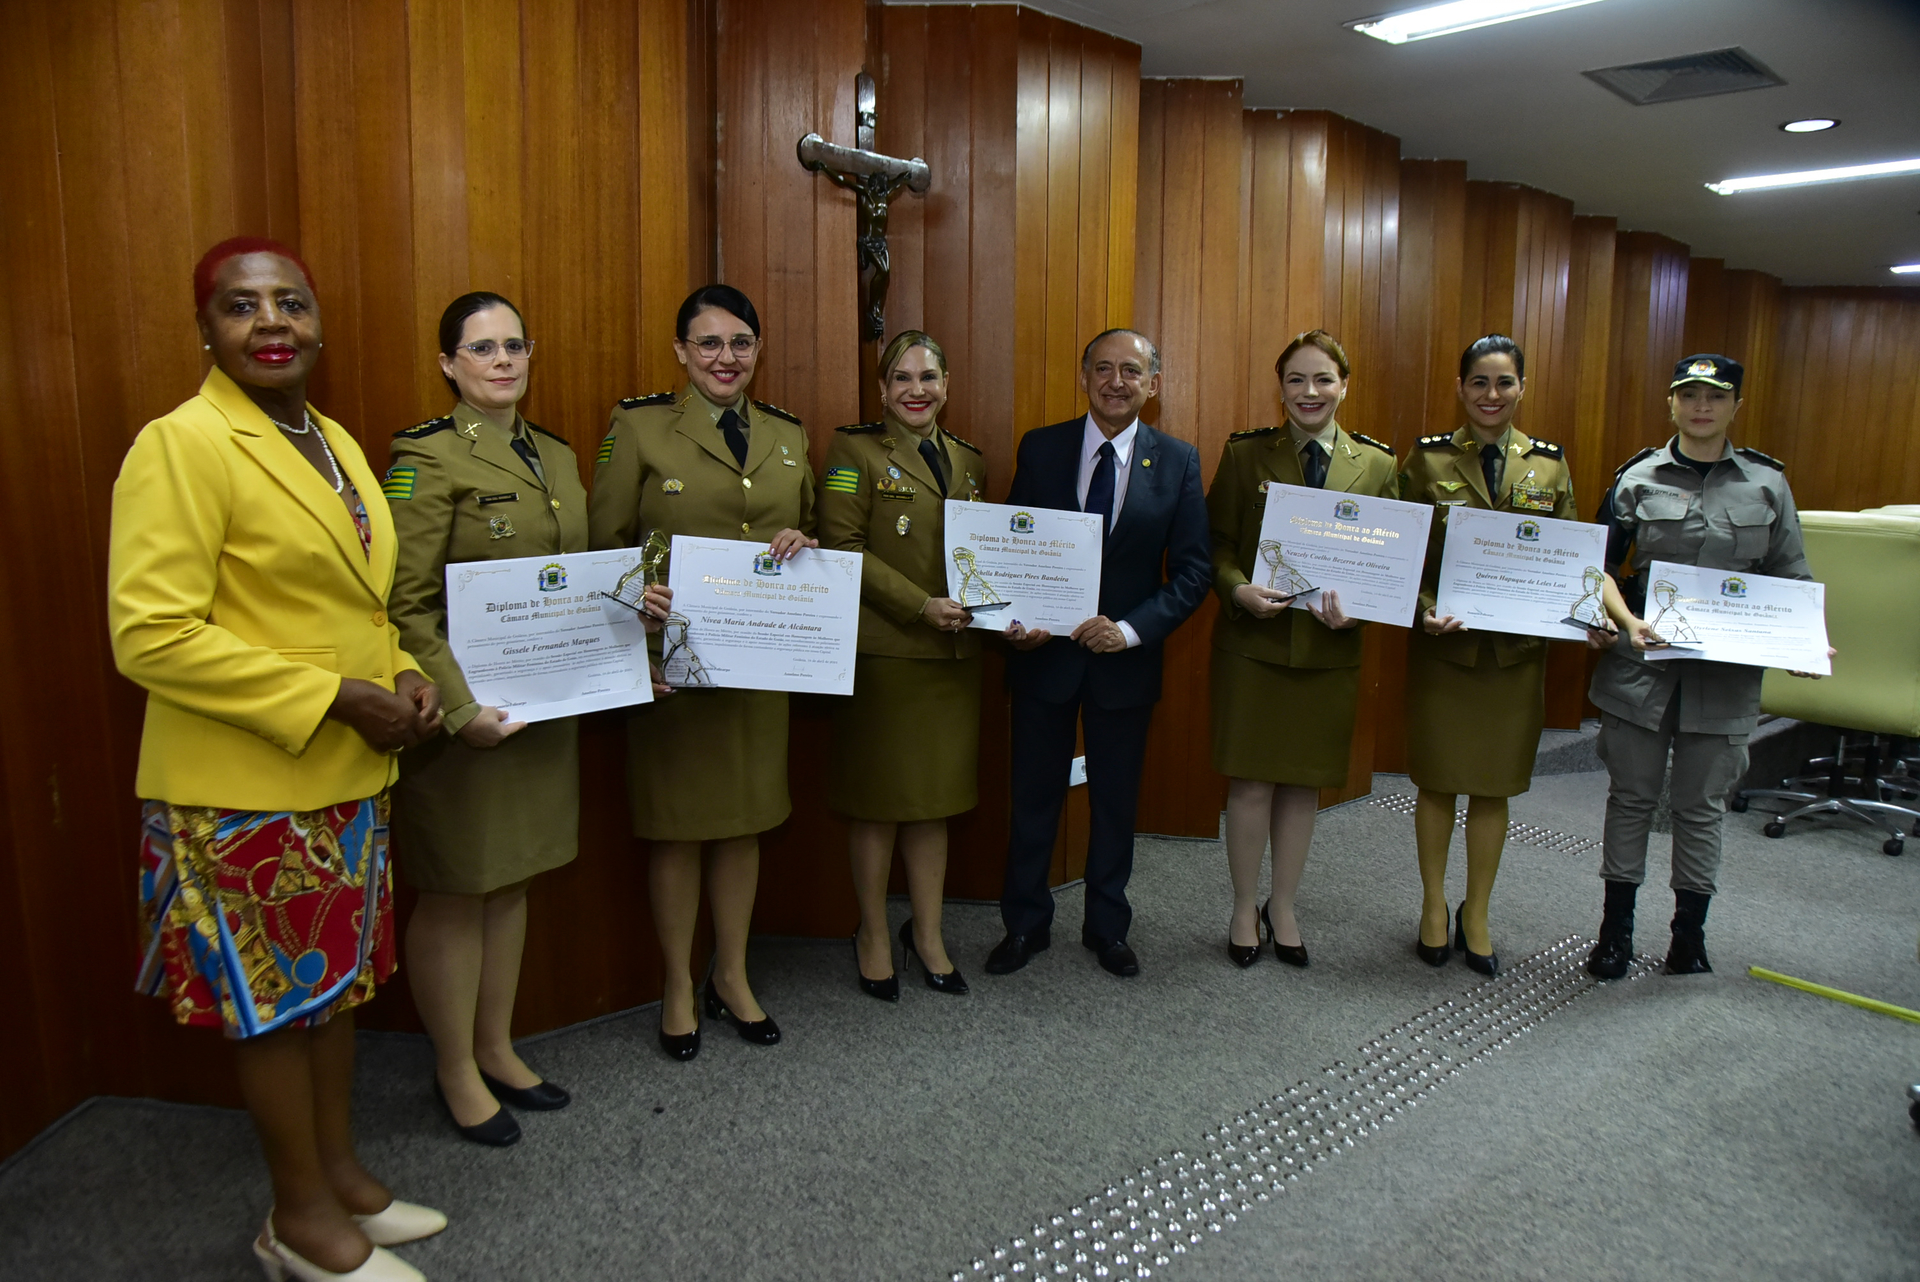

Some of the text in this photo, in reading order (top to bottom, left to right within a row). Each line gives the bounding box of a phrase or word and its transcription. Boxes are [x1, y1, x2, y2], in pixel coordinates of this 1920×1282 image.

[1335, 522, 1359, 532] Honra
[1372, 528, 1399, 538] Mérito
[969, 533, 999, 542] Diploma
[1012, 536, 1036, 545] Honra
[1049, 540, 1075, 549] Mérito
[1323, 531, 1352, 540] Municipal
[1361, 536, 1384, 545] Goiânia
[1001, 546, 1029, 554] Municipal
[1474, 537, 1504, 548] Diploma
[1517, 543, 1540, 553] Honra
[1553, 548, 1579, 558] Mérito
[1285, 550, 1308, 559] Neuzely
[1332, 557, 1356, 565] Bezerra
[1366, 562, 1390, 570] Oliveira
[1506, 552, 1534, 561] Municipal
[1543, 557, 1565, 565] Goiânia
[994, 570, 1022, 579] Rodrigues
[1041, 574, 1069, 582] Bandeira
[1476, 572, 1498, 580] Quéren
[1499, 575, 1526, 584] Hapuque
[702, 575, 741, 586] Diploma
[743, 579, 753, 587] de
[756, 579, 784, 590] Honra
[799, 583, 829, 593] Mérito
[743, 590, 776, 600] Municipal
[788, 594, 813, 602] Goiânia
[486, 601, 527, 613] Diploma
[530, 599, 540, 608] de
[543, 596, 571, 608] Honra
[1712, 608, 1742, 616] Municipal
[1723, 600, 1749, 609] Honra
[1763, 604, 1792, 613] Mérito
[501, 614, 529, 623] Câmara
[531, 609, 565, 620] Municipal
[576, 605, 601, 614] Goiânia
[701, 616, 721, 624] Nívea
[746, 620, 776, 629] Andrade
[788, 623, 822, 631] Alcântara
[503, 646, 530, 655] Gissele
[532, 641, 569, 652] Fernandes
[571, 637, 600, 646] Marques
